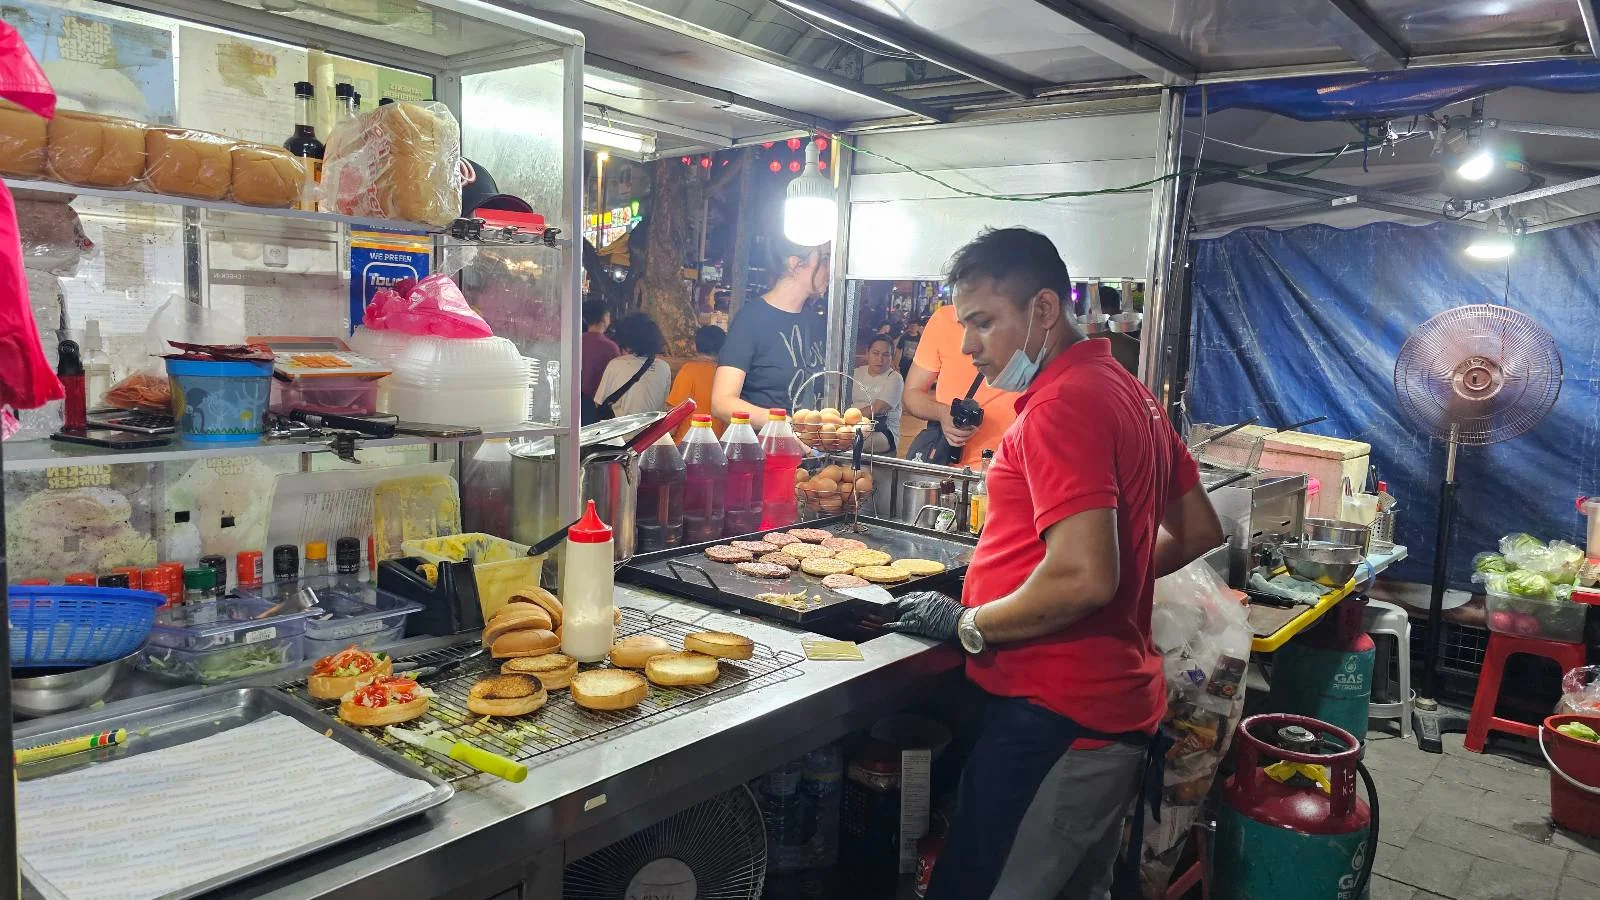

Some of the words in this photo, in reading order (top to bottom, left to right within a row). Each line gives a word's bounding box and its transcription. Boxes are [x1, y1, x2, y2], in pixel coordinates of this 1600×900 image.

[369, 252, 383, 260] WE
[384, 254, 412, 262] PREFER
[1334, 673, 1364, 684] GAS
